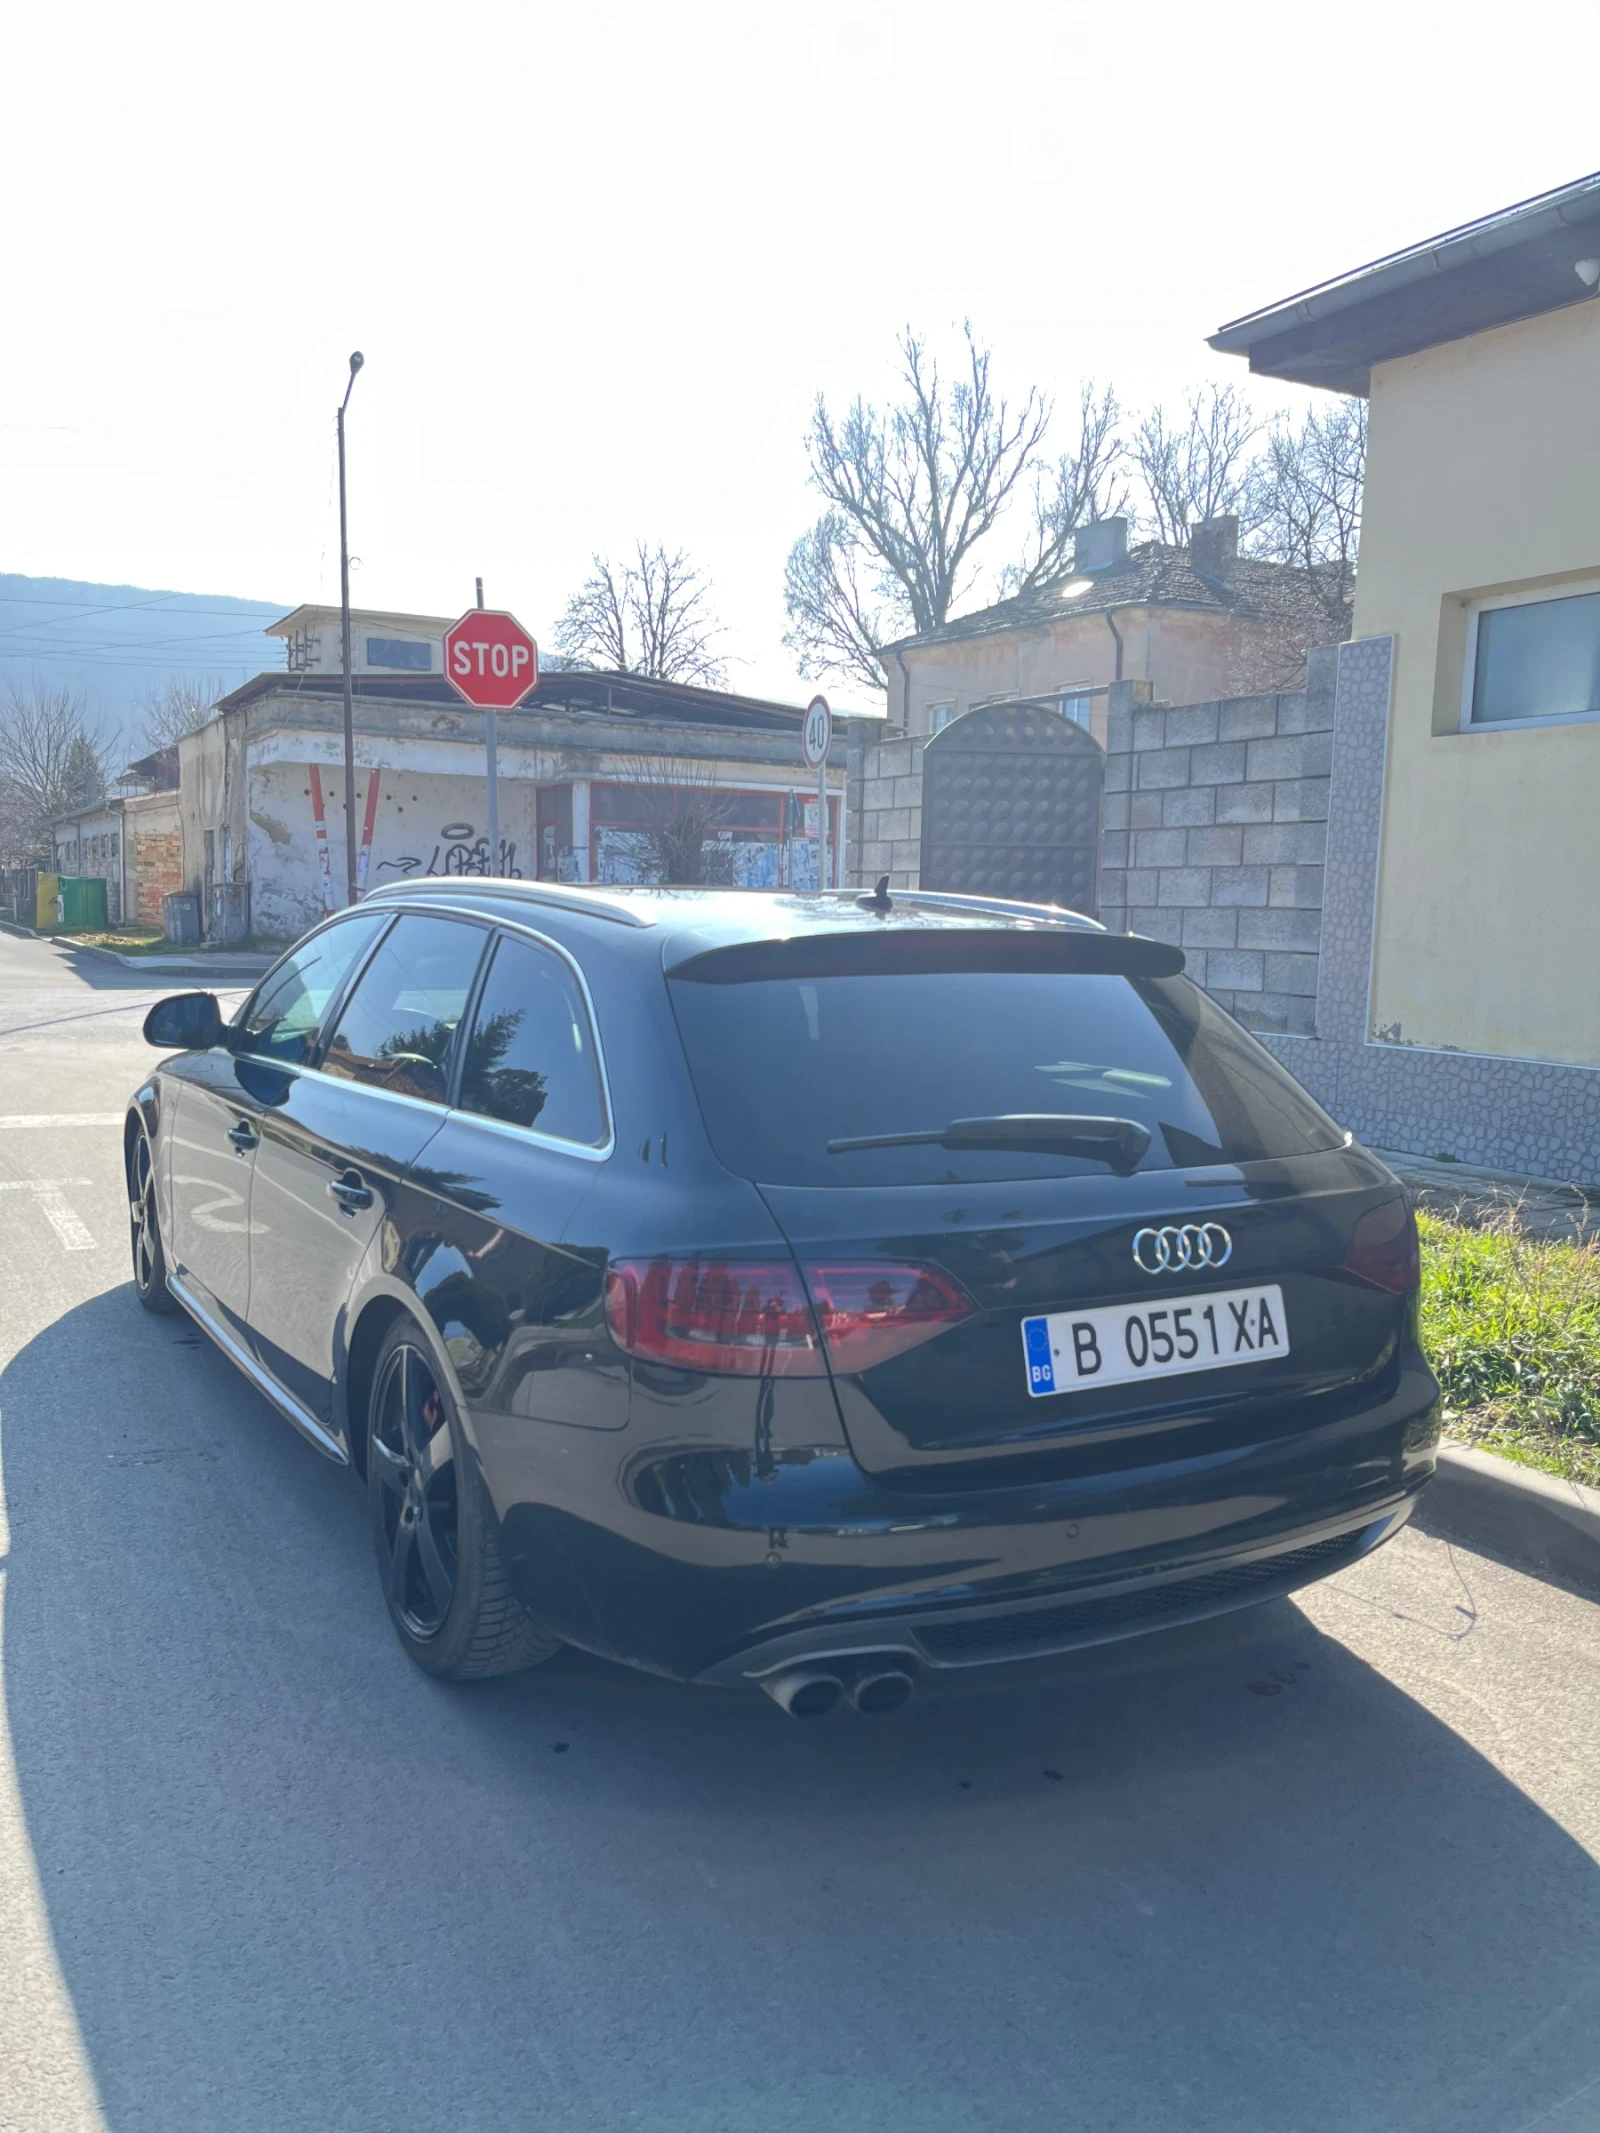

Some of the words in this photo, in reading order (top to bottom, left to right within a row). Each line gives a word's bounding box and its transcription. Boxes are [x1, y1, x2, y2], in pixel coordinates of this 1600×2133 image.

[453, 640, 530, 678] STOP
[808, 714, 826, 751] 40
[1071, 1321, 1103, 1377] B
[1124, 1303, 1220, 1368] 0551
[1227, 1297, 1280, 1353] XA
[1031, 1363, 1052, 1383] BG
